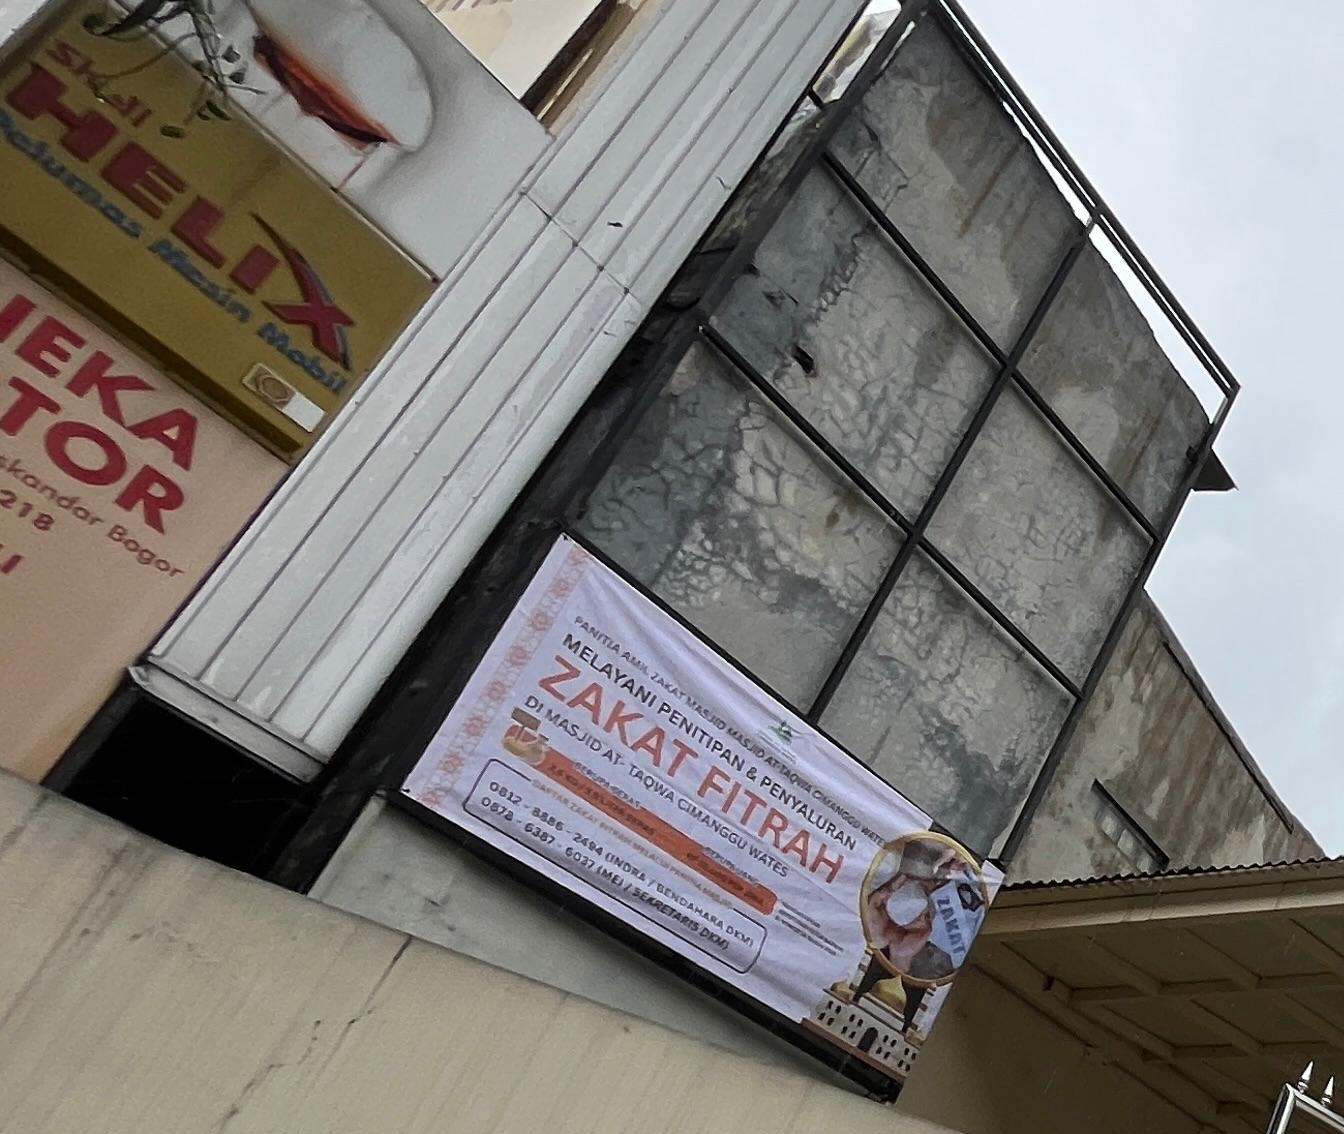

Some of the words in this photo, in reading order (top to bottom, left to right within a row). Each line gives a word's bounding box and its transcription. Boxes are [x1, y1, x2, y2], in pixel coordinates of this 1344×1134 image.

[5, 62, 355, 370] HELIX
[257, 321, 349, 394] Mobil
[0, 376, 185, 535] TOR
[107, 525, 185, 578] Bogor
[524, 695, 544, 714] DI
[544, 708, 603, 754] MASJID
[627, 765, 676, 804] TAQWA
[676, 797, 747, 851] CIMANGGU
[748, 845, 788, 877] WATES
[536, 654, 698, 783] ZAKAT
[697, 765, 845, 884] FITRAH
[562, 633, 655, 707] MELAYANI
[658, 702, 744, 770] PENITIPAN
[746, 766, 758, 781] &
[760, 776, 855, 850] PENYALURAN
[575, 616, 619, 652] PANITIA
[622, 651, 647, 672] AMIL
[651, 672, 683, 699] ZAKAT
[685, 697, 724, 729] MASJID
[727, 728, 763, 758] MASJID
[861, 827, 885, 848] WATE
[488, 781, 521, 805] 0812
[655, 883, 724, 928] BENDAHARA
[524, 823, 554, 844] 6387
[633, 888, 698, 930] SEKRETARIS
